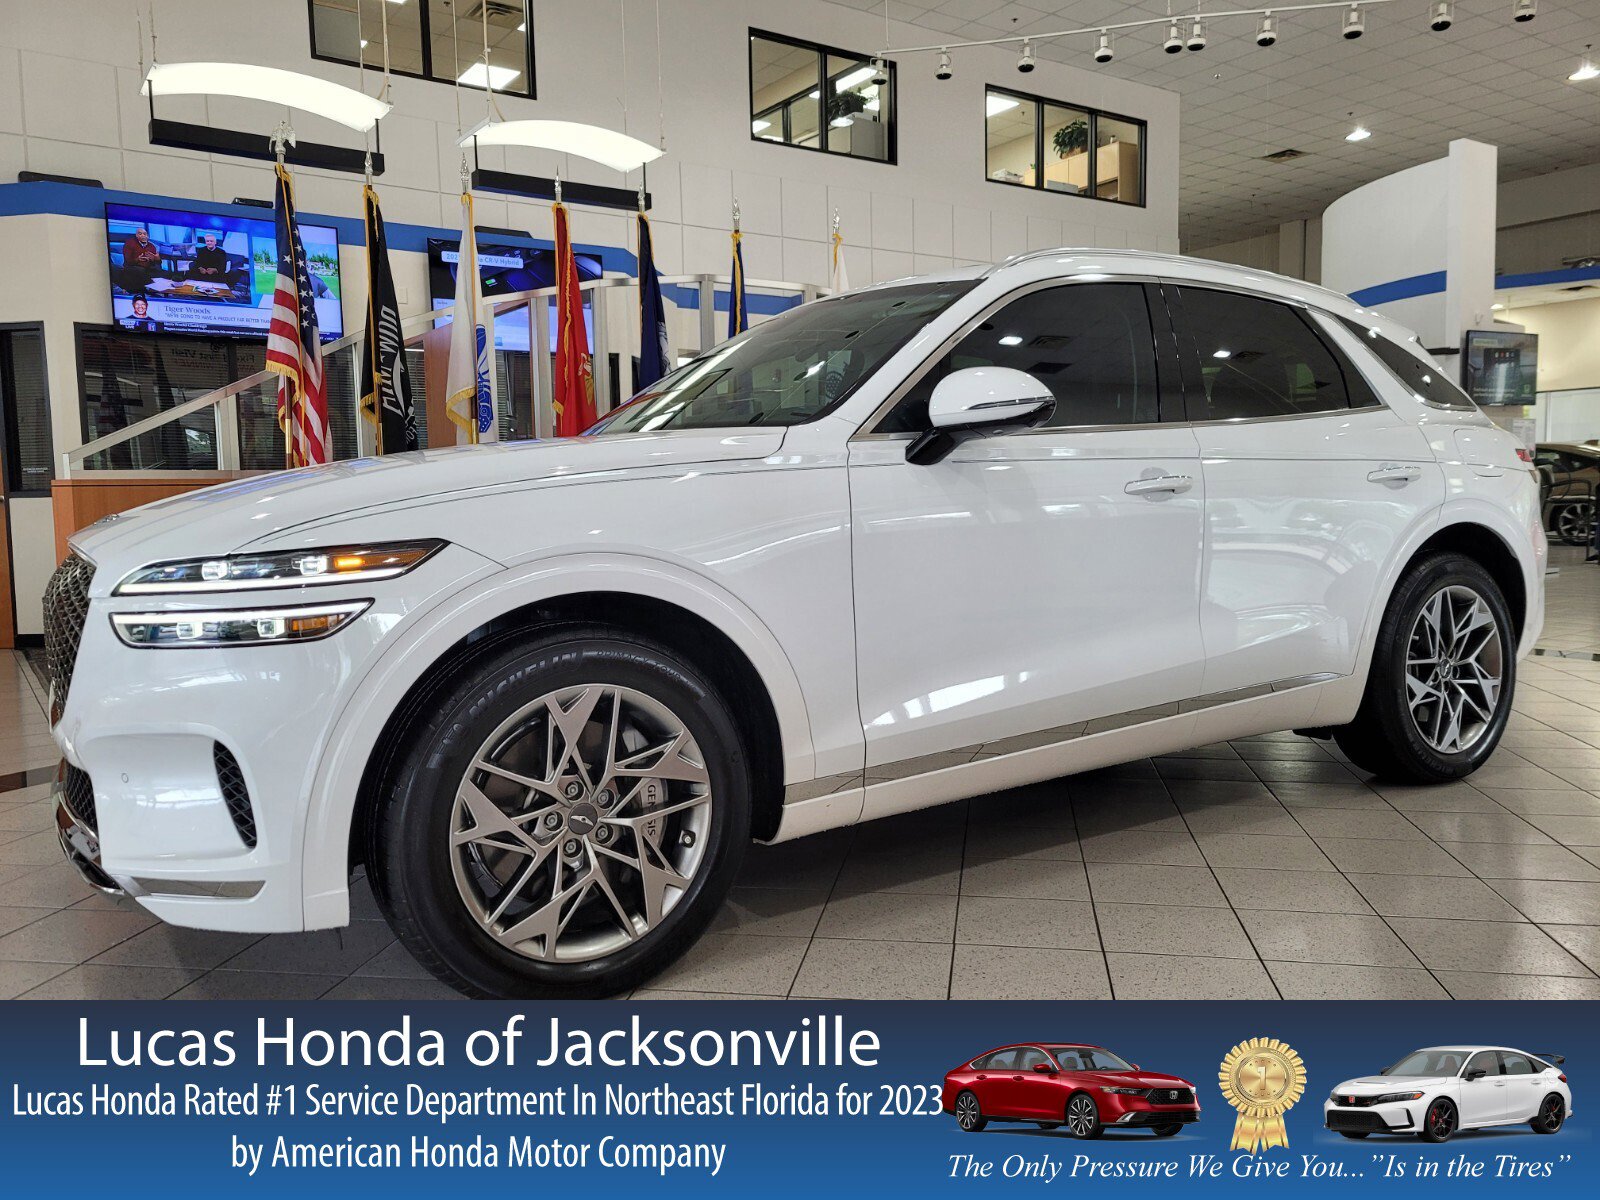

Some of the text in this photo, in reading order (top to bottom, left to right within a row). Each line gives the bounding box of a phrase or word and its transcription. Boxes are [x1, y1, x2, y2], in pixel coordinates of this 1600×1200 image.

[500, 258, 520, 266] Hybrid
[164, 305, 210, 314] Tiger Woods
[647, 784, 656, 836] GENSIS
